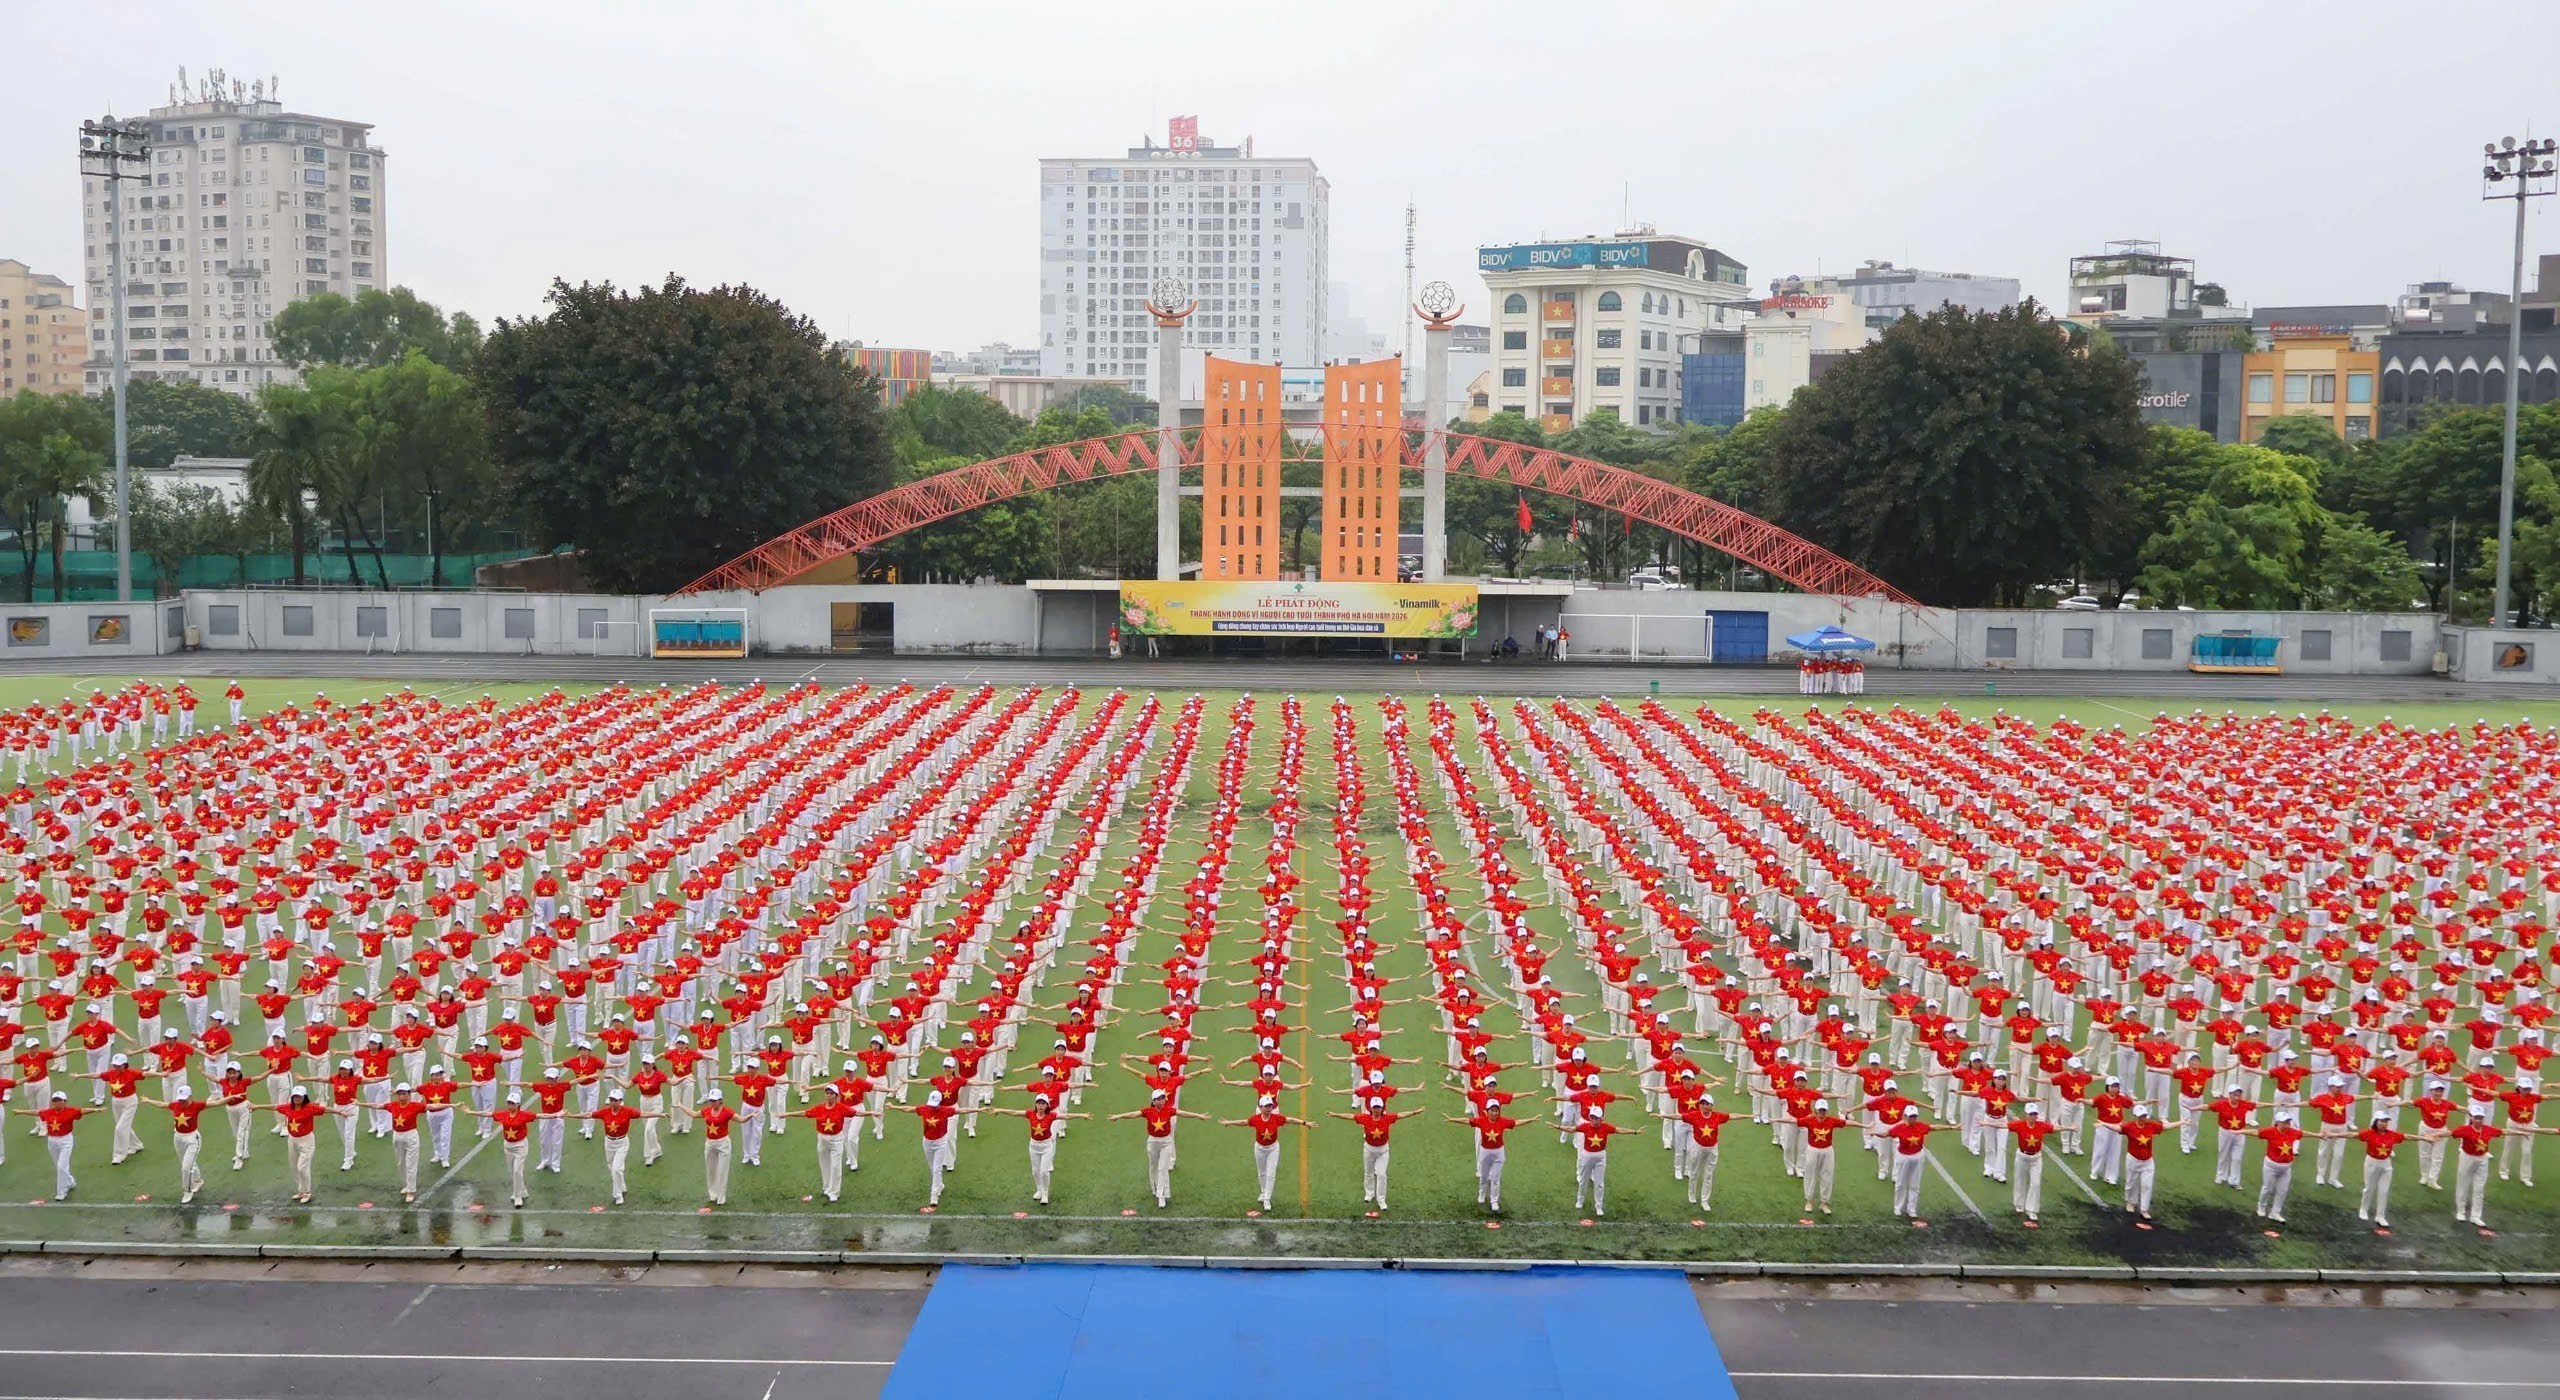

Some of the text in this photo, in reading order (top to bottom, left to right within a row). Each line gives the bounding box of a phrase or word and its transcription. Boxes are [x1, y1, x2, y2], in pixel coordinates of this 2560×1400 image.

[1173, 136, 1193, 148] 36
[1481, 253, 1508, 266] BIDV
[1530, 249, 1561, 264] BIDV
[1600, 249, 1629, 262] BIDV
[1275, 597, 1305, 608] PHÁT
[1308, 597, 1340, 610] ĐỘNG
[1399, 599, 1440, 609] Vinamilk
